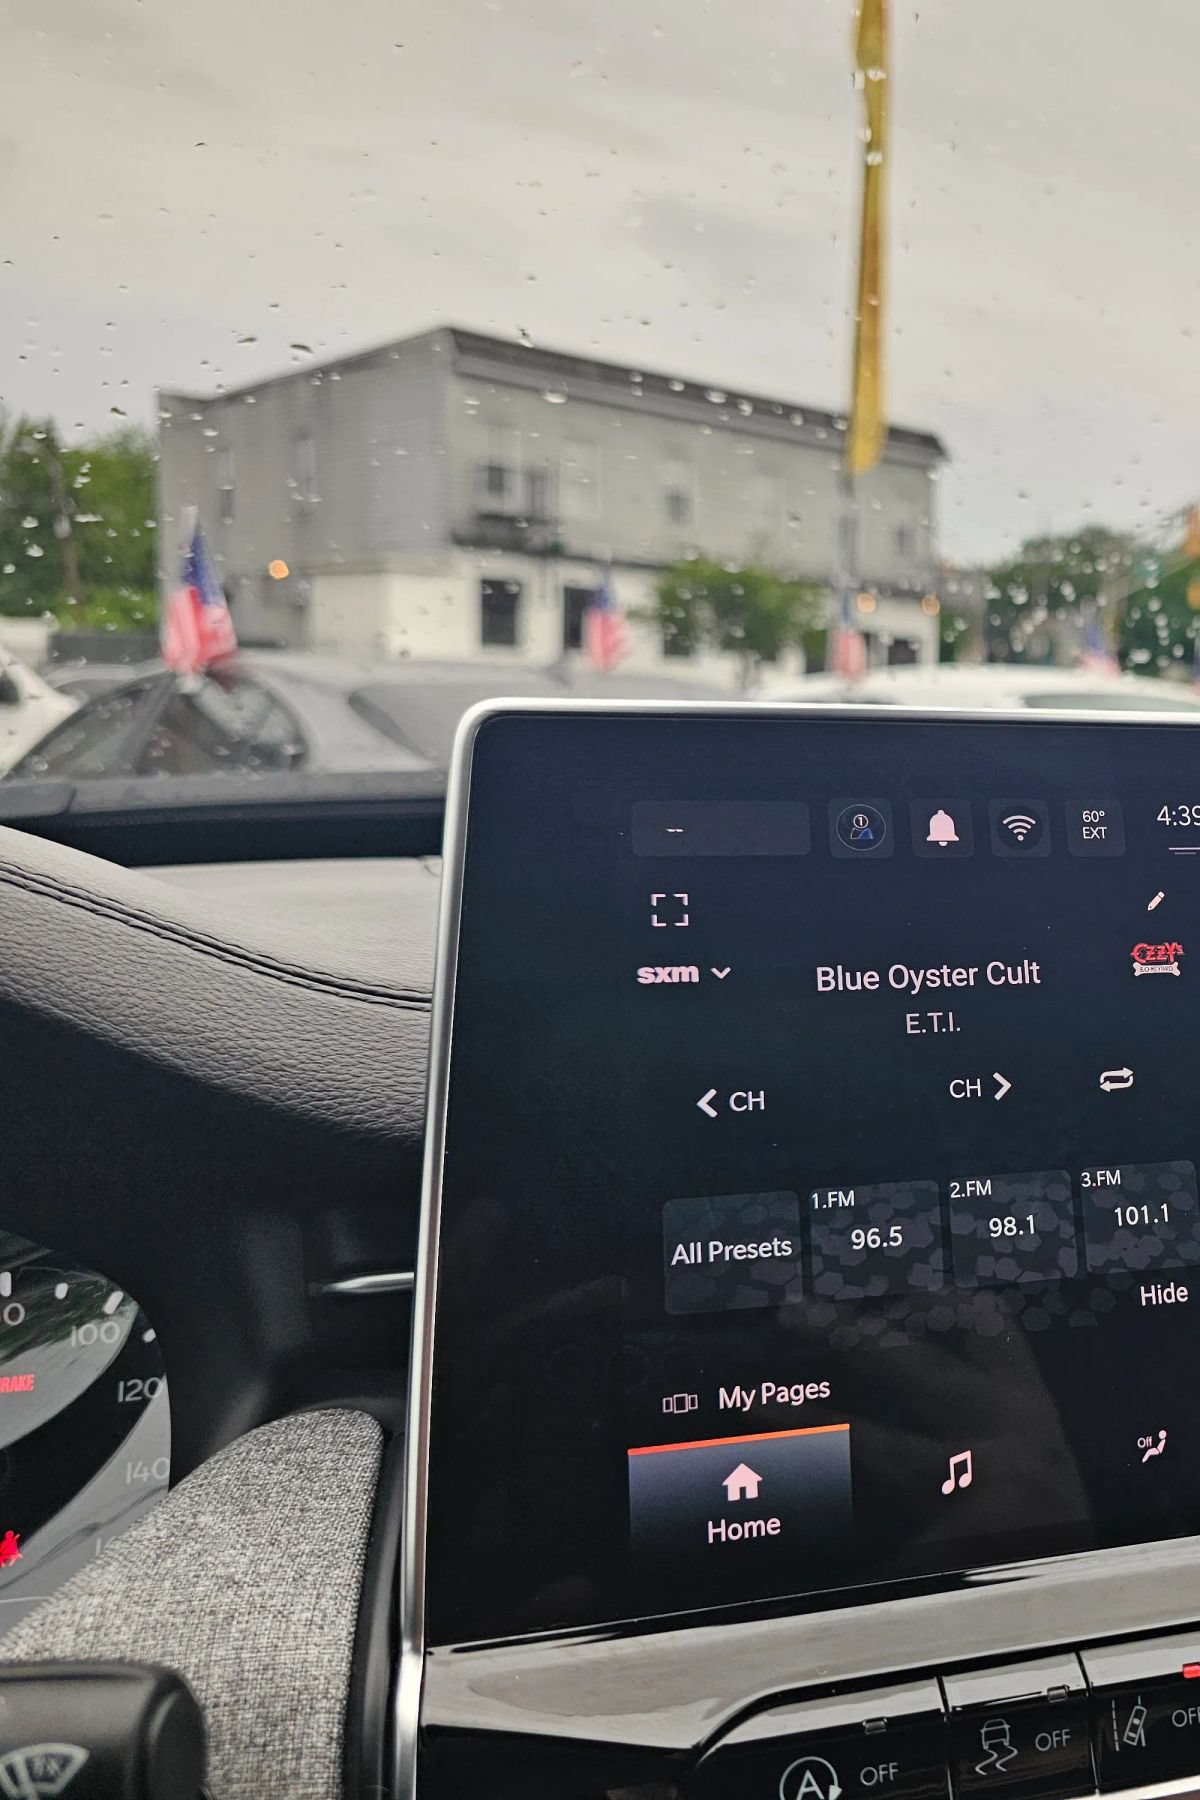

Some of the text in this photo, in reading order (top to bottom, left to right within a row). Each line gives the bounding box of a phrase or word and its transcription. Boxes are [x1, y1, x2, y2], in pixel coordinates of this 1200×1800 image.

[1082, 810, 1106, 823] 60°
[1082, 826, 1108, 839] EXT
[637, 965, 700, 984] sxm
[816, 959, 1041, 995] Blue Oyster Cult
[905, 1011, 961, 1034] E.T.I.
[949, 1078, 982, 1099] CH
[729, 1090, 765, 1112] CH
[949, 1179, 992, 1199] 2.FM
[1081, 1169, 1121, 1188] 3.FM
[811, 1190, 855, 1210] 1.FM
[989, 1214, 1036, 1238] 98.1
[1114, 1203, 1170, 1227] 101.1
[850, 1225, 903, 1250] 96.5
[671, 1236, 793, 1266] All Presets
[1140, 1282, 1189, 1306] Hide
[0, 1303, 25, 1326] 0
[71, 1320, 121, 1347] 100
[117, 1376, 164, 1403] 120
[719, 1379, 831, 1413] My Pages
[1136, 1436, 1154, 1449] Off
[125, 1457, 170, 1485] 140
[707, 1517, 781, 1544] Home
[1034, 1728, 1071, 1752] OFF
[859, 1761, 899, 1787] OFF
